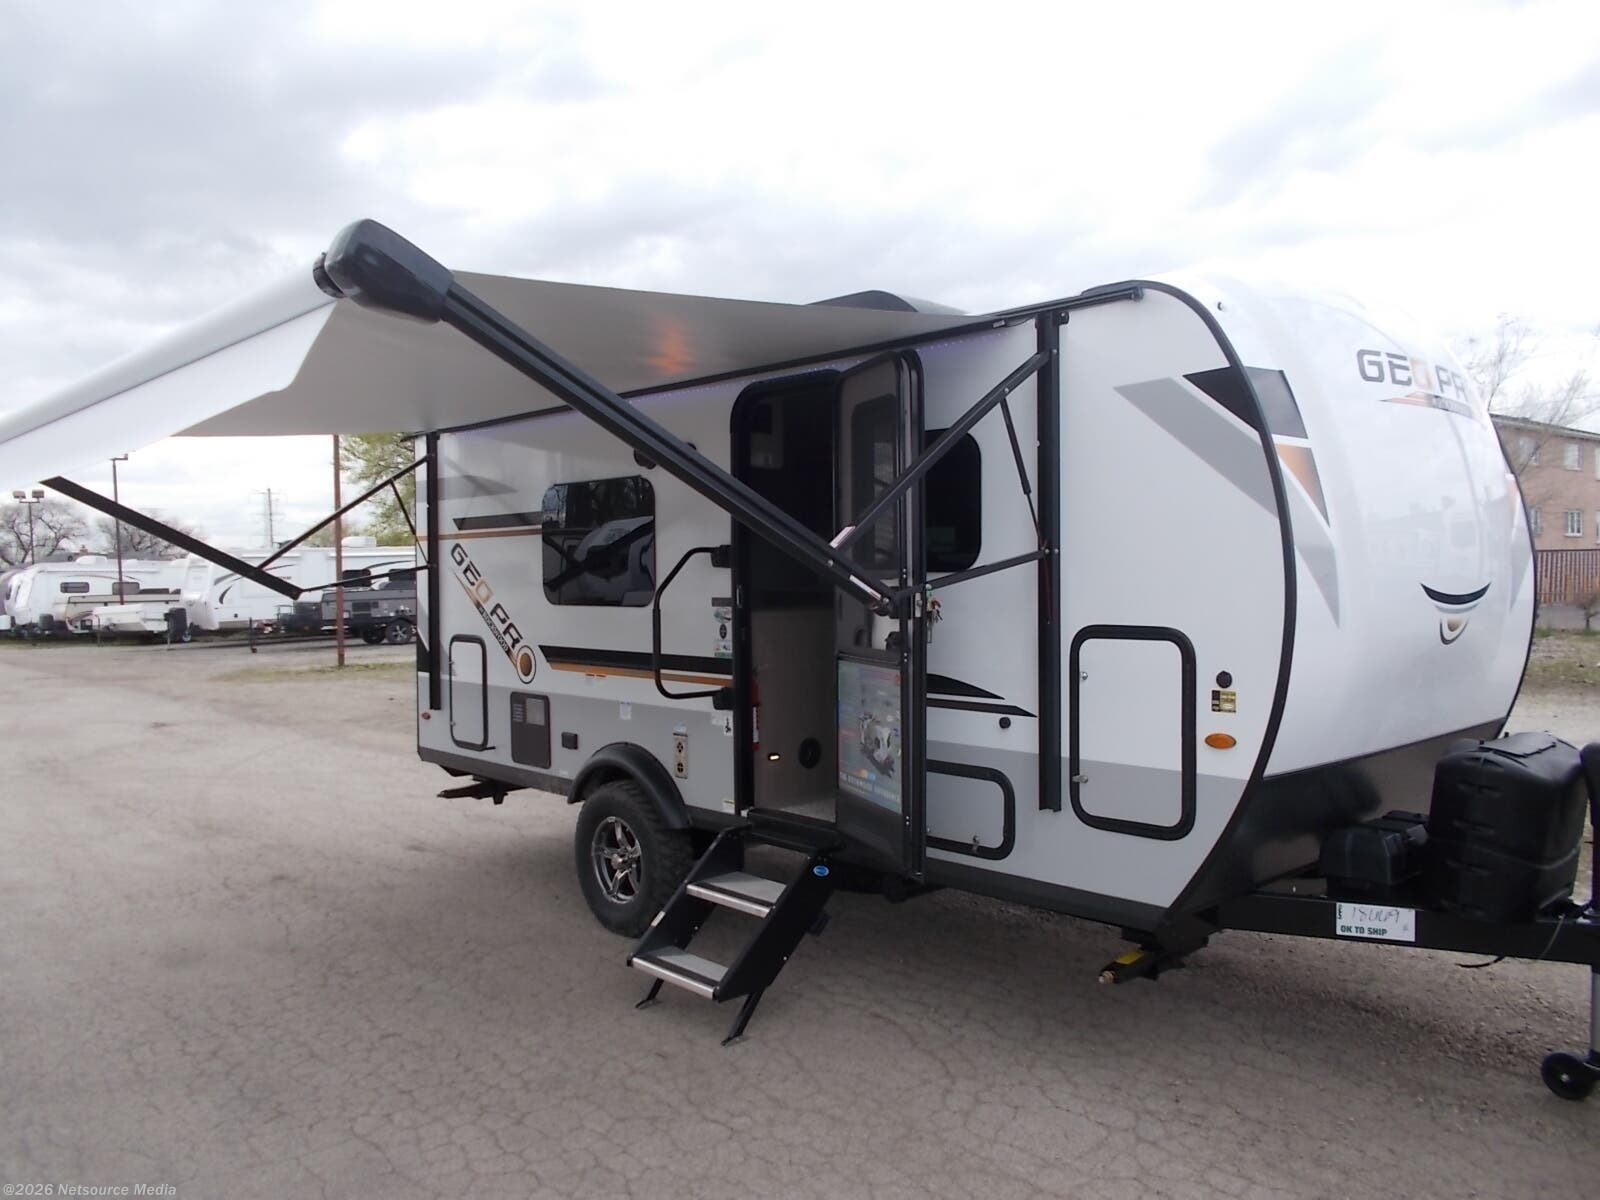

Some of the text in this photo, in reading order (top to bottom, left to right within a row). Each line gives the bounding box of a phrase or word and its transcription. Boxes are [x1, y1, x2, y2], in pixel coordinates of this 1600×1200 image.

[1356, 348, 1470, 403] GEO PR
[450, 542, 494, 604] GEO
[1340, 924, 1388, 936] OK TO SHIP
